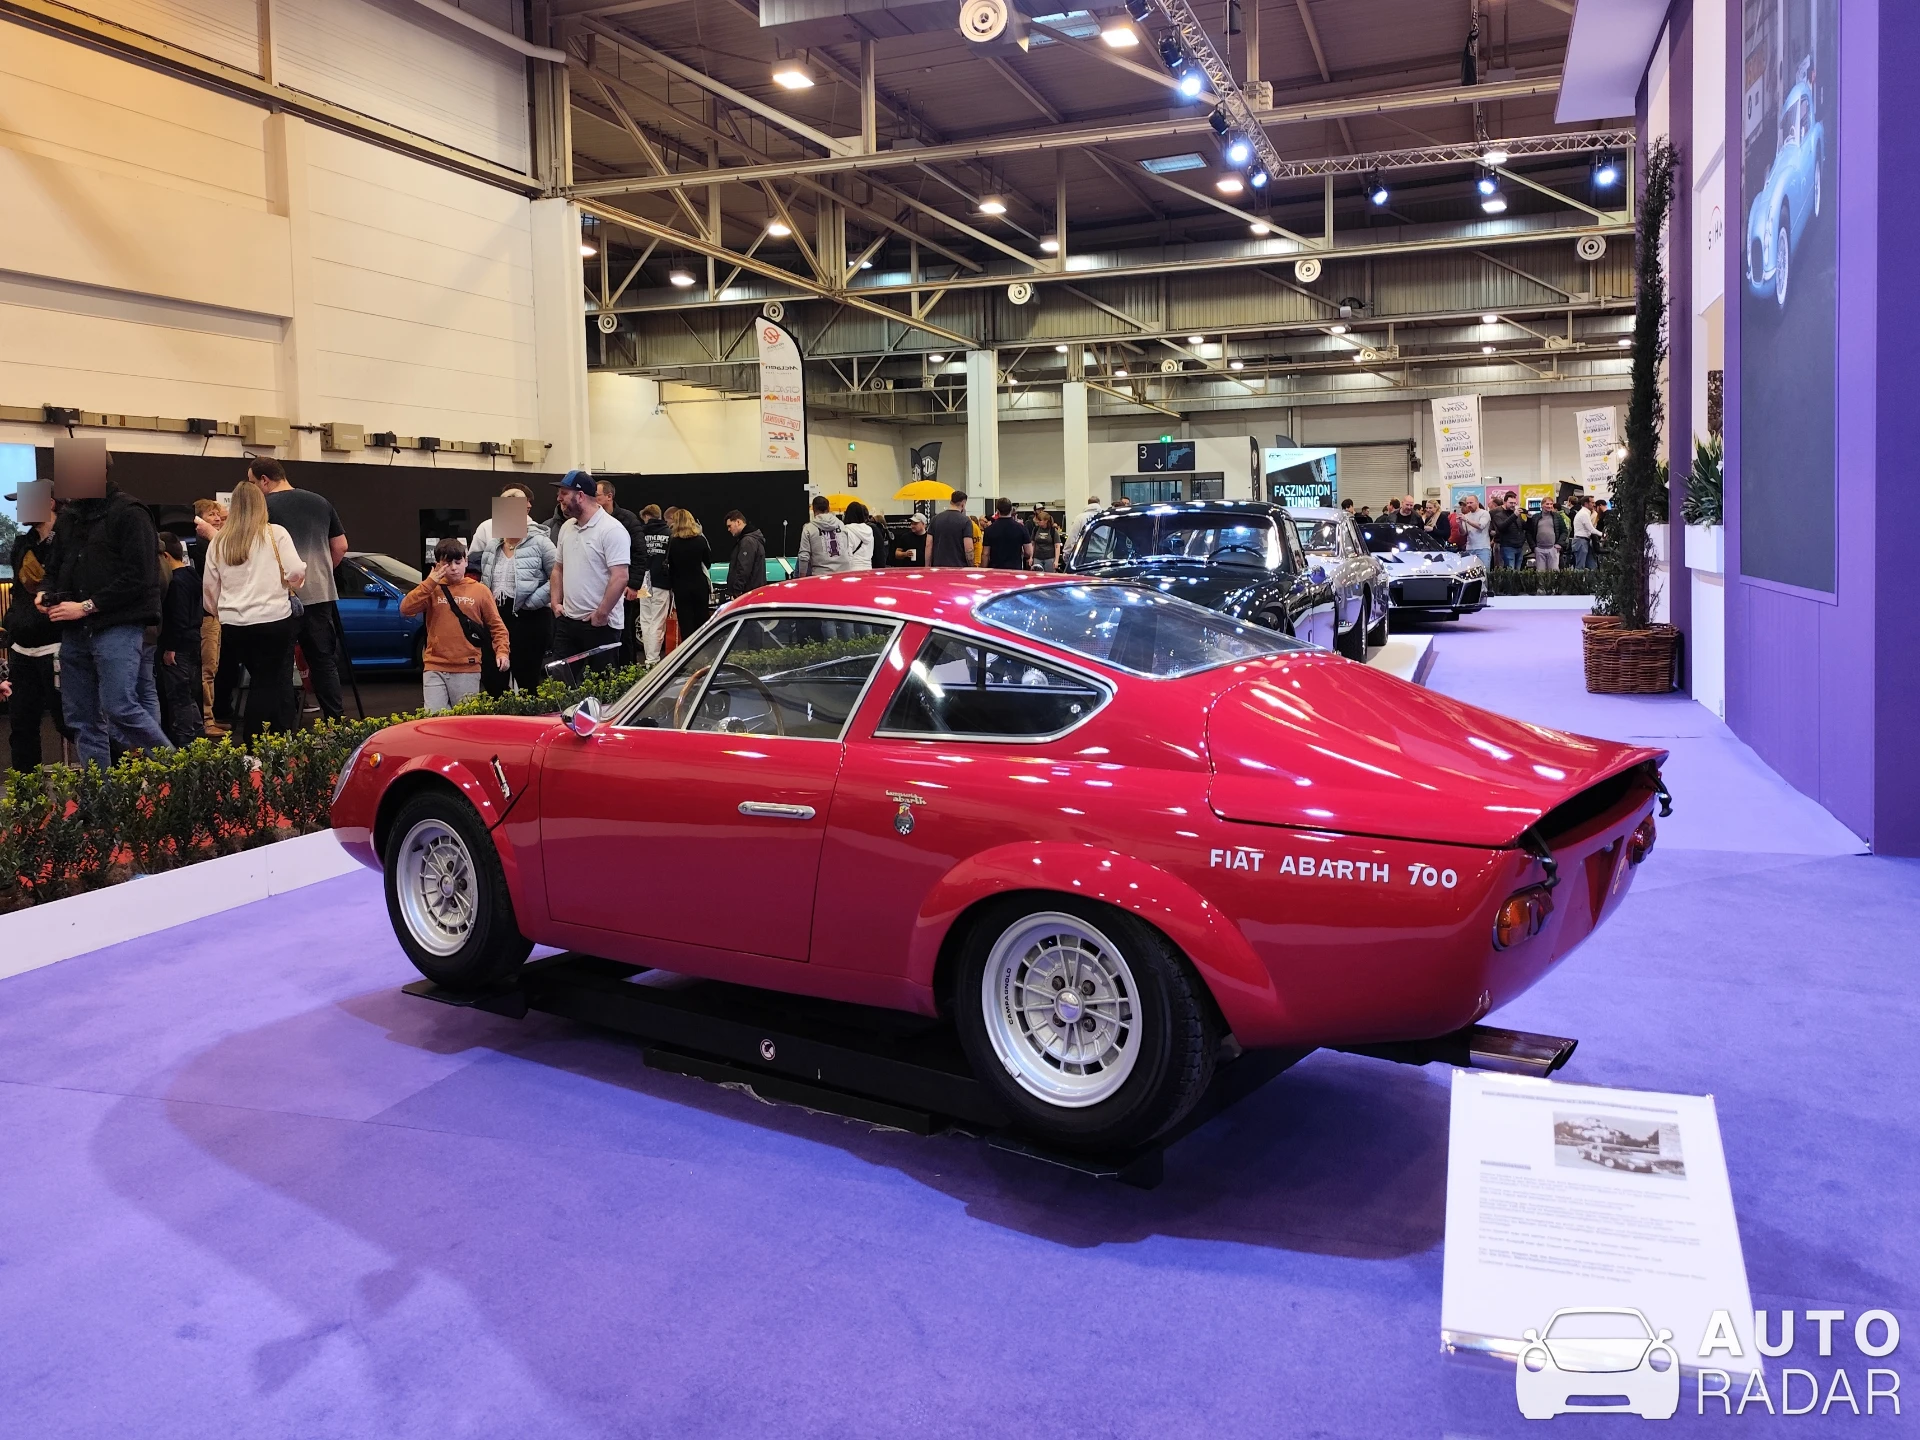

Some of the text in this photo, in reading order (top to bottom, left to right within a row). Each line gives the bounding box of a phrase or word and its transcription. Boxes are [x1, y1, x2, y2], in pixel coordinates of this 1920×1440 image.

[1140, 445, 1148, 459] 3
[1274, 484, 1331, 497] FASZINATION
[1285, 496, 1320, 509] TUNING
[1210, 849, 1458, 889] FIAT ABARTH 700
[1004, 967, 1014, 1025] CAMPAGNOLO
